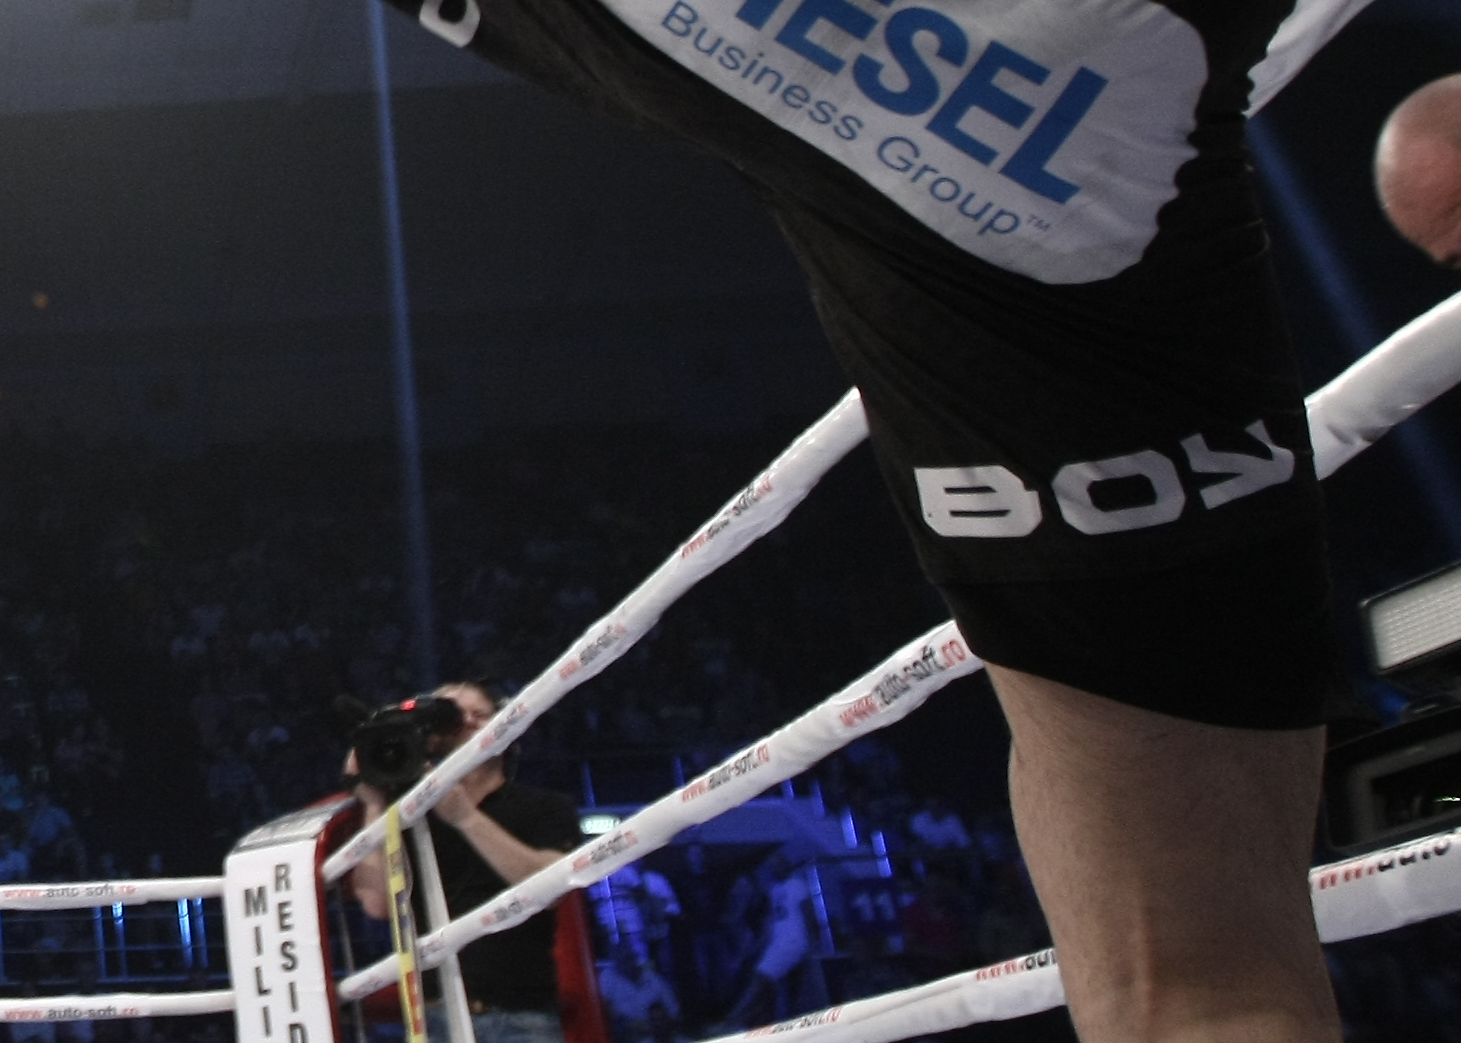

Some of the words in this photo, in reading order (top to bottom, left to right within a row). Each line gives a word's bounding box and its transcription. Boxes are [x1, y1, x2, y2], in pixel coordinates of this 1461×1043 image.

[660, 0, 865, 143] Business
[875, 134, 1022, 237] Group
[913, 419, 1296, 539] BOY
[839, 639, 967, 728] www.auto-soft.ro
